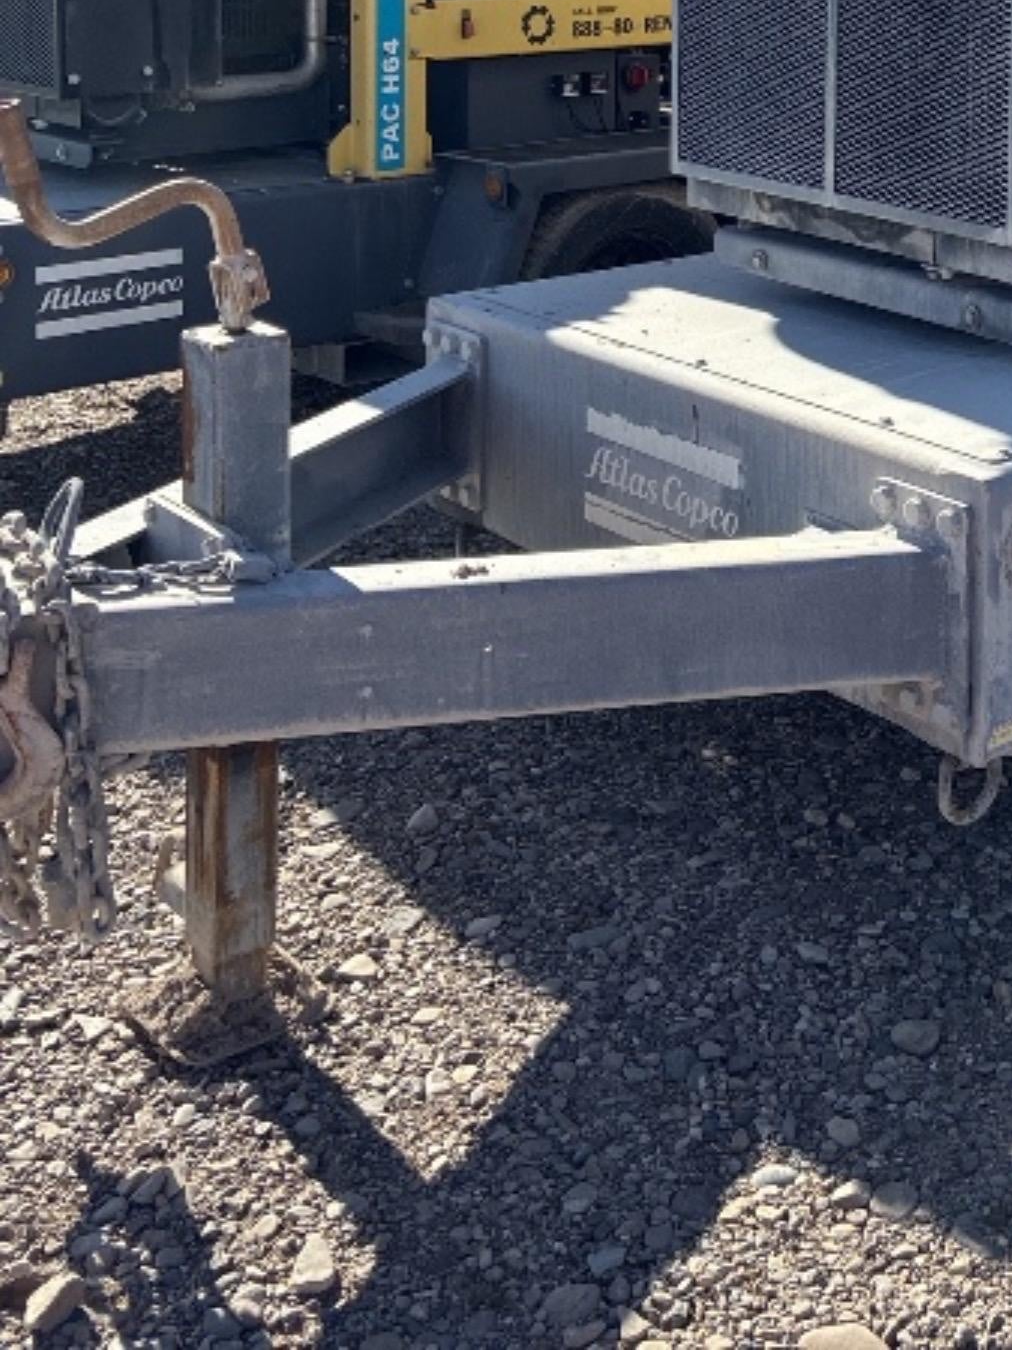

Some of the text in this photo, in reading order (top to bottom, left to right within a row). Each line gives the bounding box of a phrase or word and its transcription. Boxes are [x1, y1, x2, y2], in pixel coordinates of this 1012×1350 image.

[380, 36, 400, 162] PAC H64
[36, 274, 184, 314] Atlas Copco
[584, 446, 740, 539] Atlas Copco
